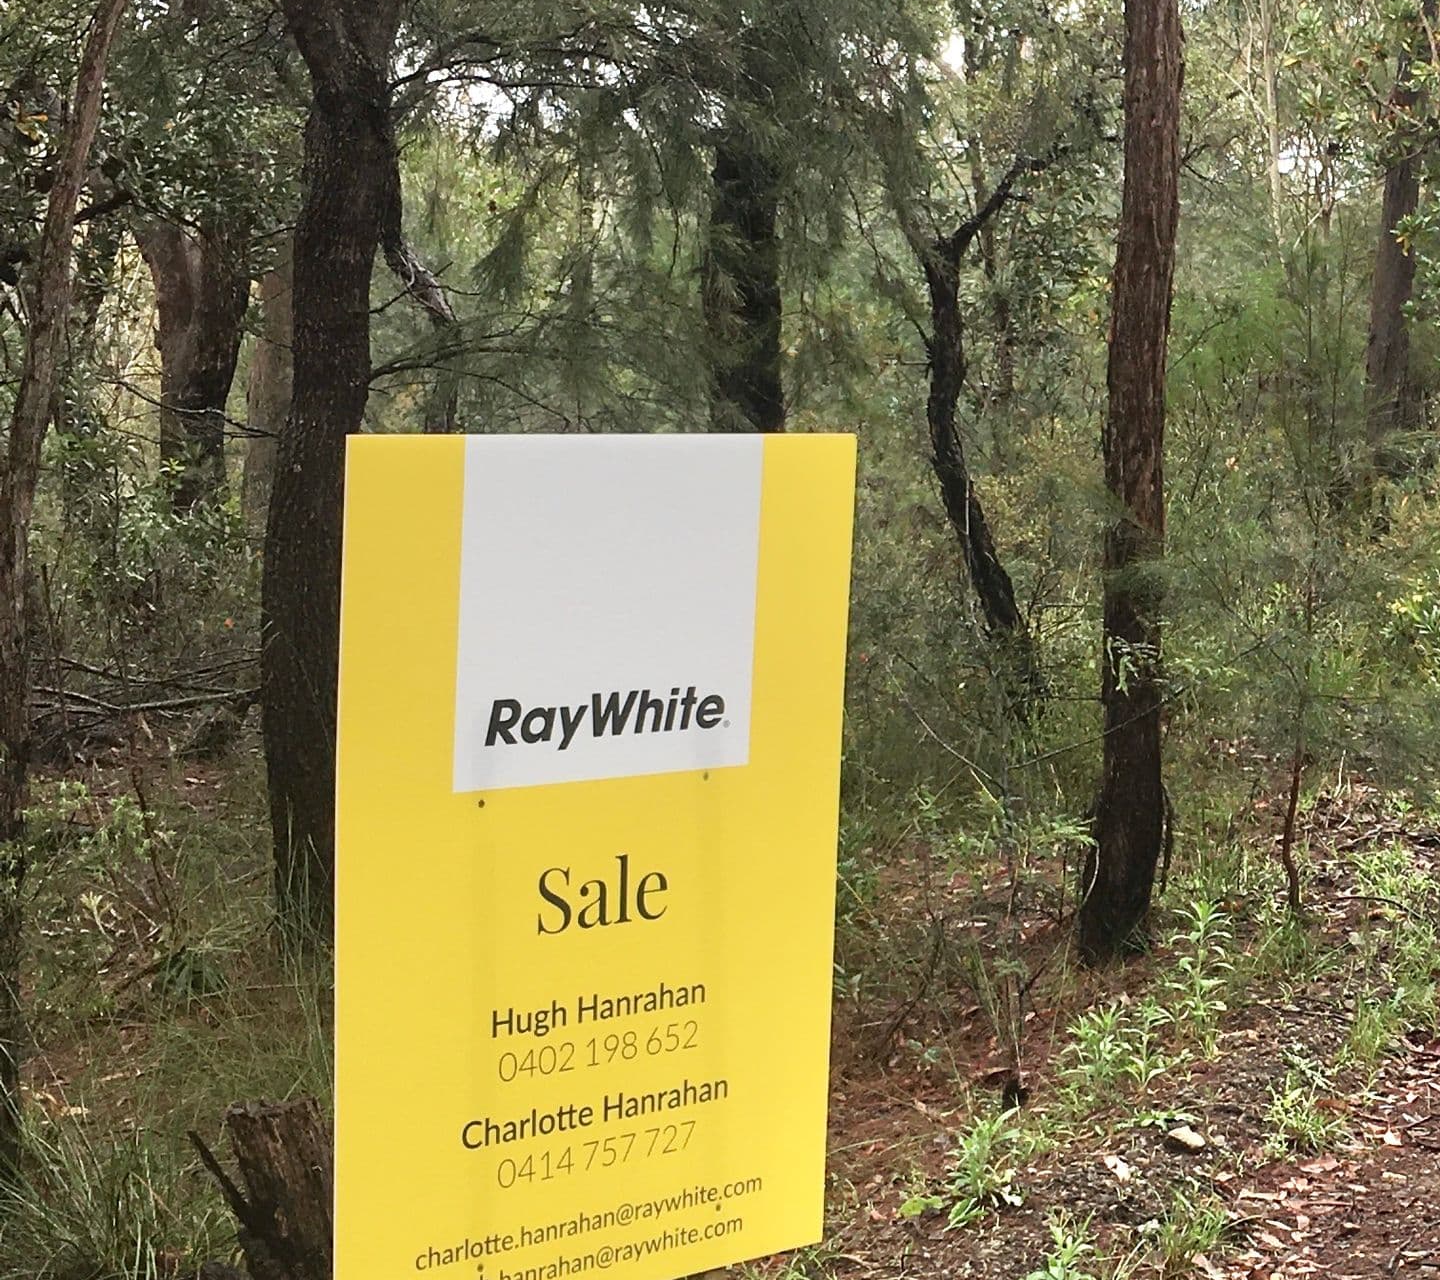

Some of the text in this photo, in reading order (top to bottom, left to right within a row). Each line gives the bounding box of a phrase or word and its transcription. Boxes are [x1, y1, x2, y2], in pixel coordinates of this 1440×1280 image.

[484, 686, 725, 751] RayWhite
[537, 854, 668, 935] Sale
[491, 982, 706, 1038] Hugh Hanrahan
[498, 1020, 699, 1082] 0402 198 652
[461, 1078, 728, 1150] Charlotte Hanrahan
[497, 1121, 696, 1188] 0414 757 727
[415, 1175, 763, 1271] charlotte.hanrahan@raywhite.com
